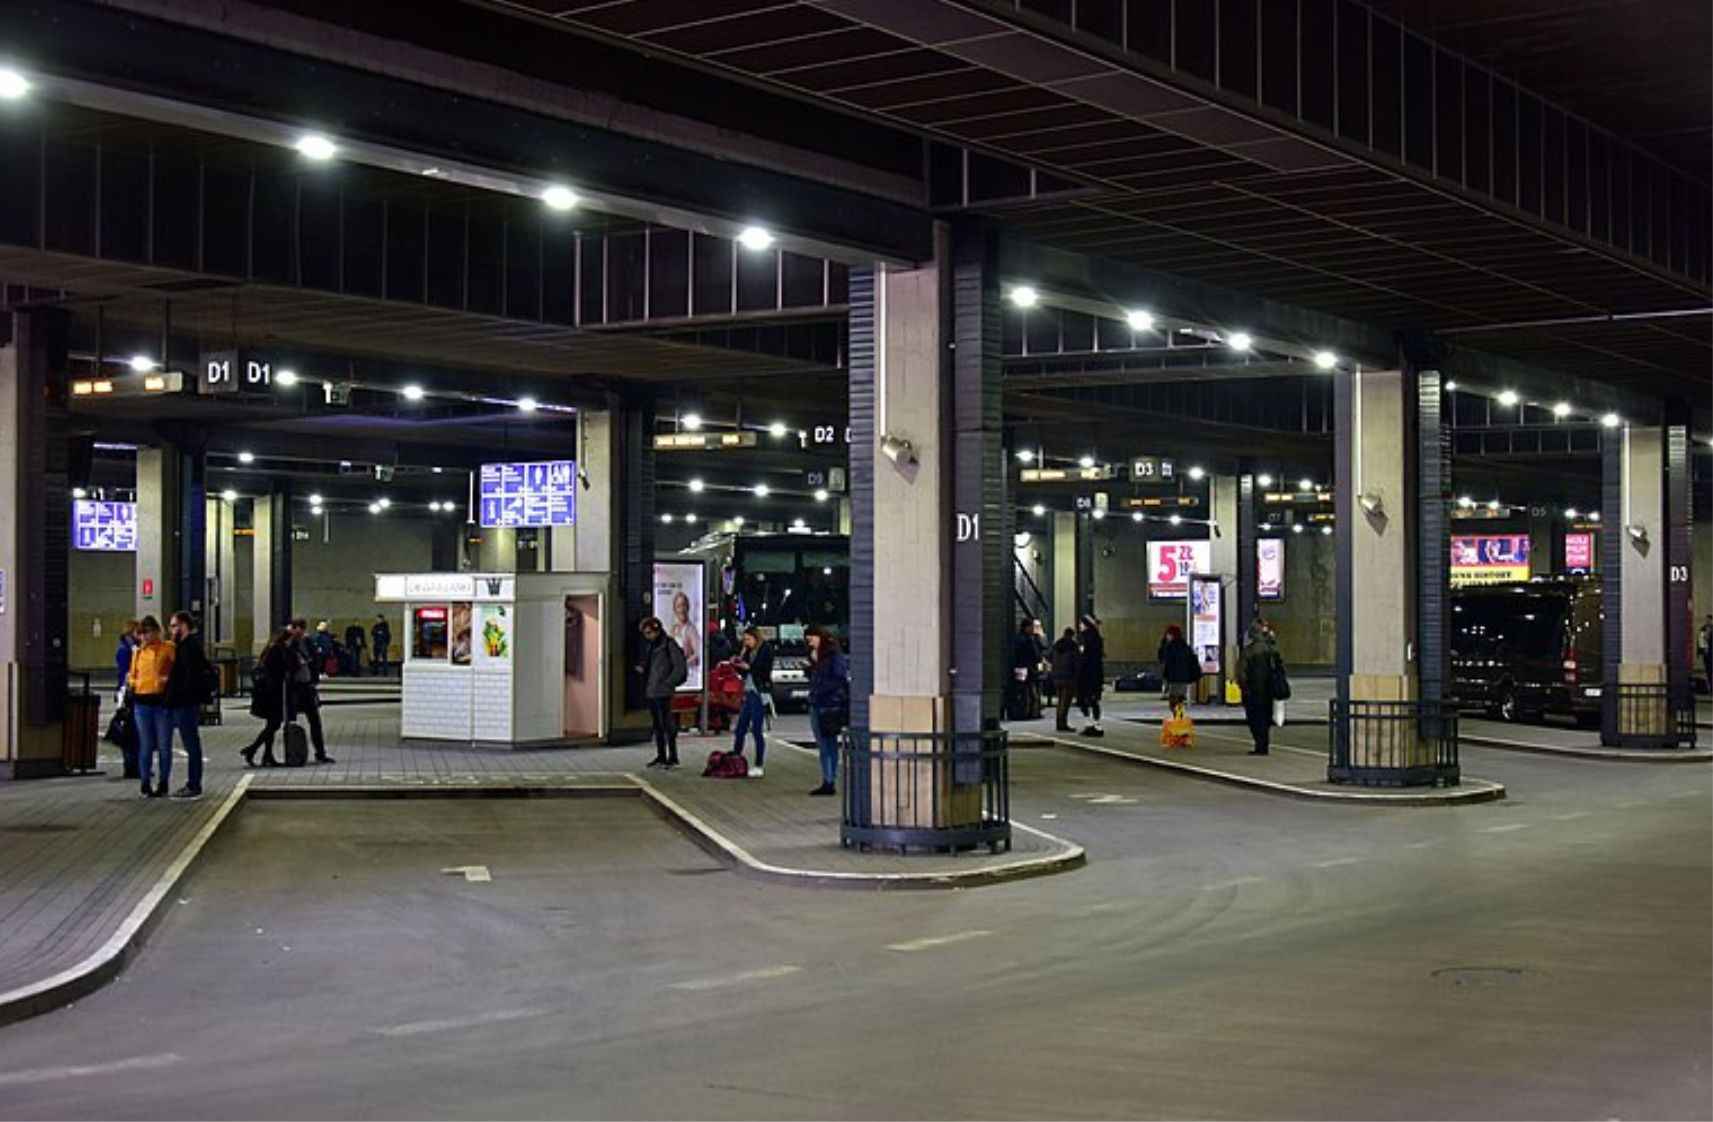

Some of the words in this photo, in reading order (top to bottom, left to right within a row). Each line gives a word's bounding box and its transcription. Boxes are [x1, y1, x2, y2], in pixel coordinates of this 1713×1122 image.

[208, 361, 230, 384] D1
[247, 361, 271, 384] D1
[814, 425, 835, 444] D2
[1135, 461, 1154, 476] D3
[957, 513, 979, 542] D1
[1157, 545, 1177, 582] 5
[1671, 566, 1688, 581] D3
